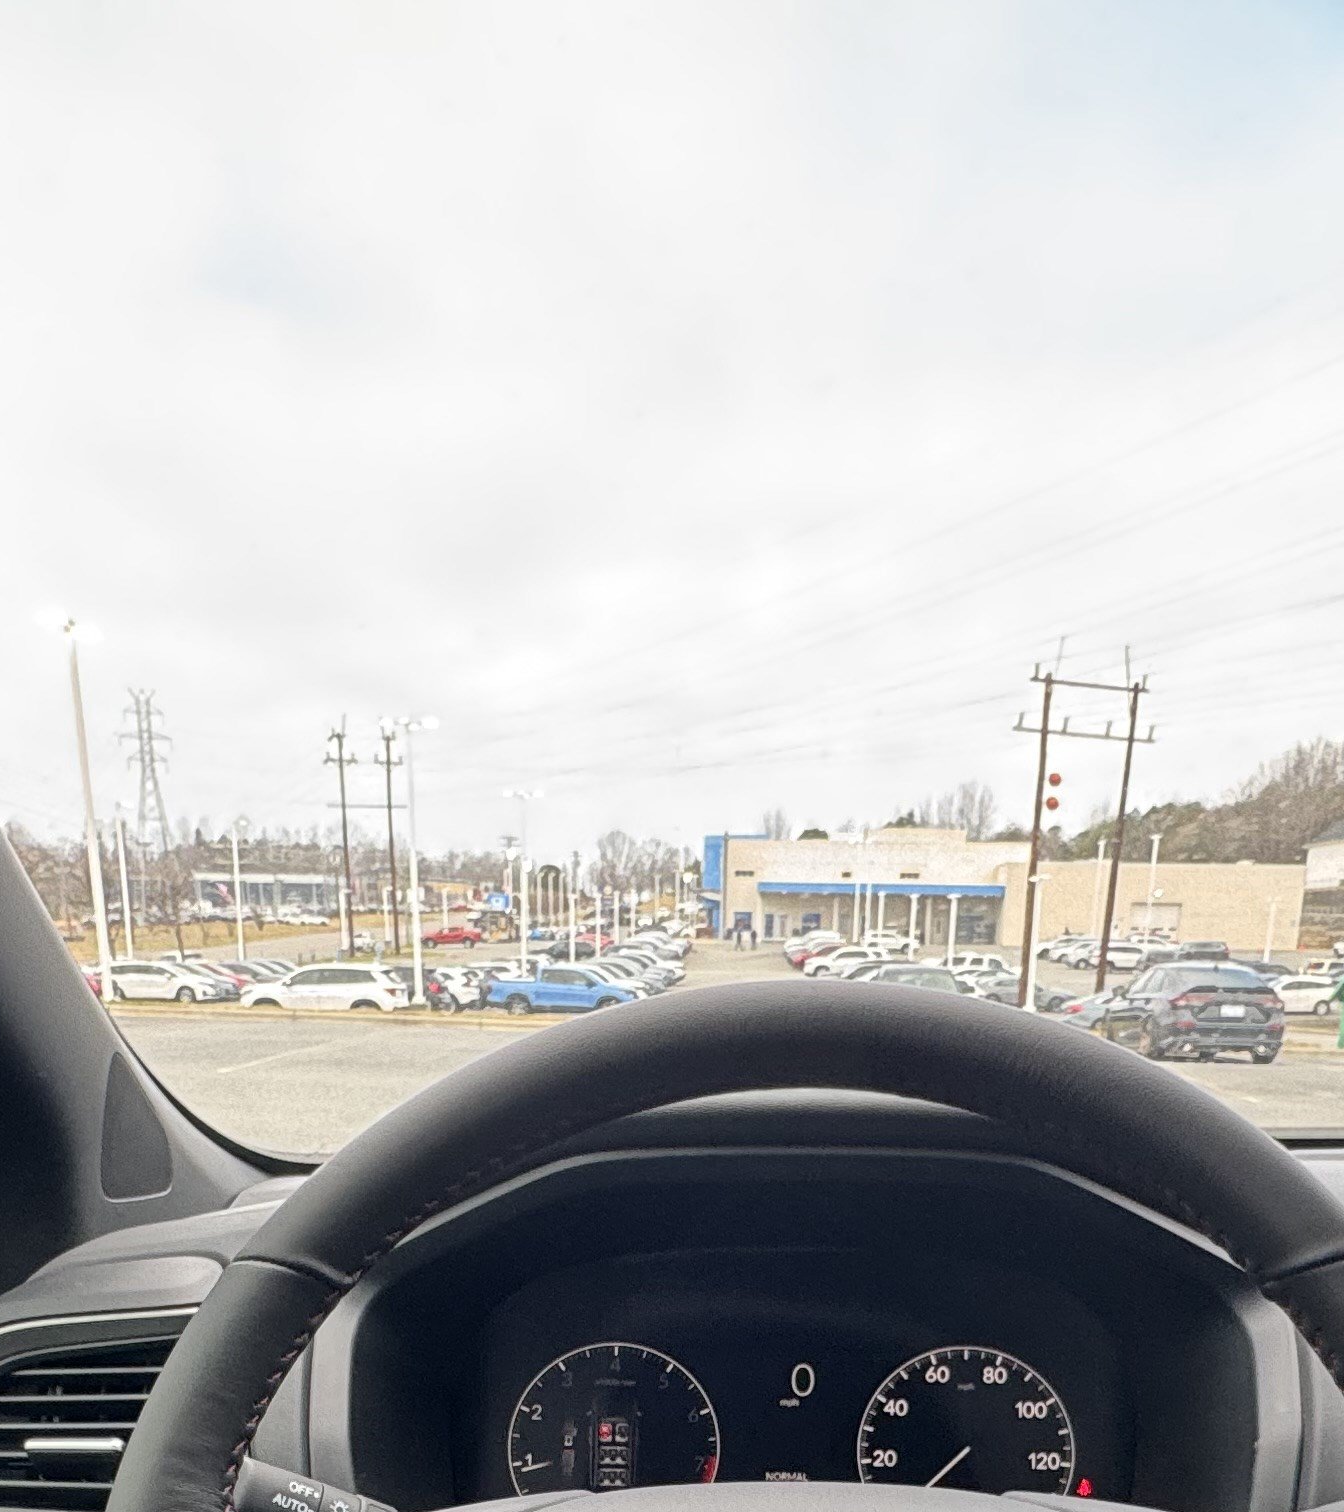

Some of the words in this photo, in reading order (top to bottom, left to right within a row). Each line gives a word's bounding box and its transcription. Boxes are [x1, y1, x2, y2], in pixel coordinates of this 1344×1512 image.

[791, 1363, 816, 1397] 0
[924, 1366, 950, 1384] 60
[982, 1366, 1007, 1384] 80
[530, 1404, 543, 1421] 2
[687, 1408, 699, 1423] 6
[883, 1399, 909, 1417] 40
[1014, 1400, 1048, 1419] 100
[523, 1452, 533, 1467] 1
[872, 1449, 898, 1468] 20
[1027, 1452, 1061, 1471] 120
[289, 1480, 313, 1498] OFF
